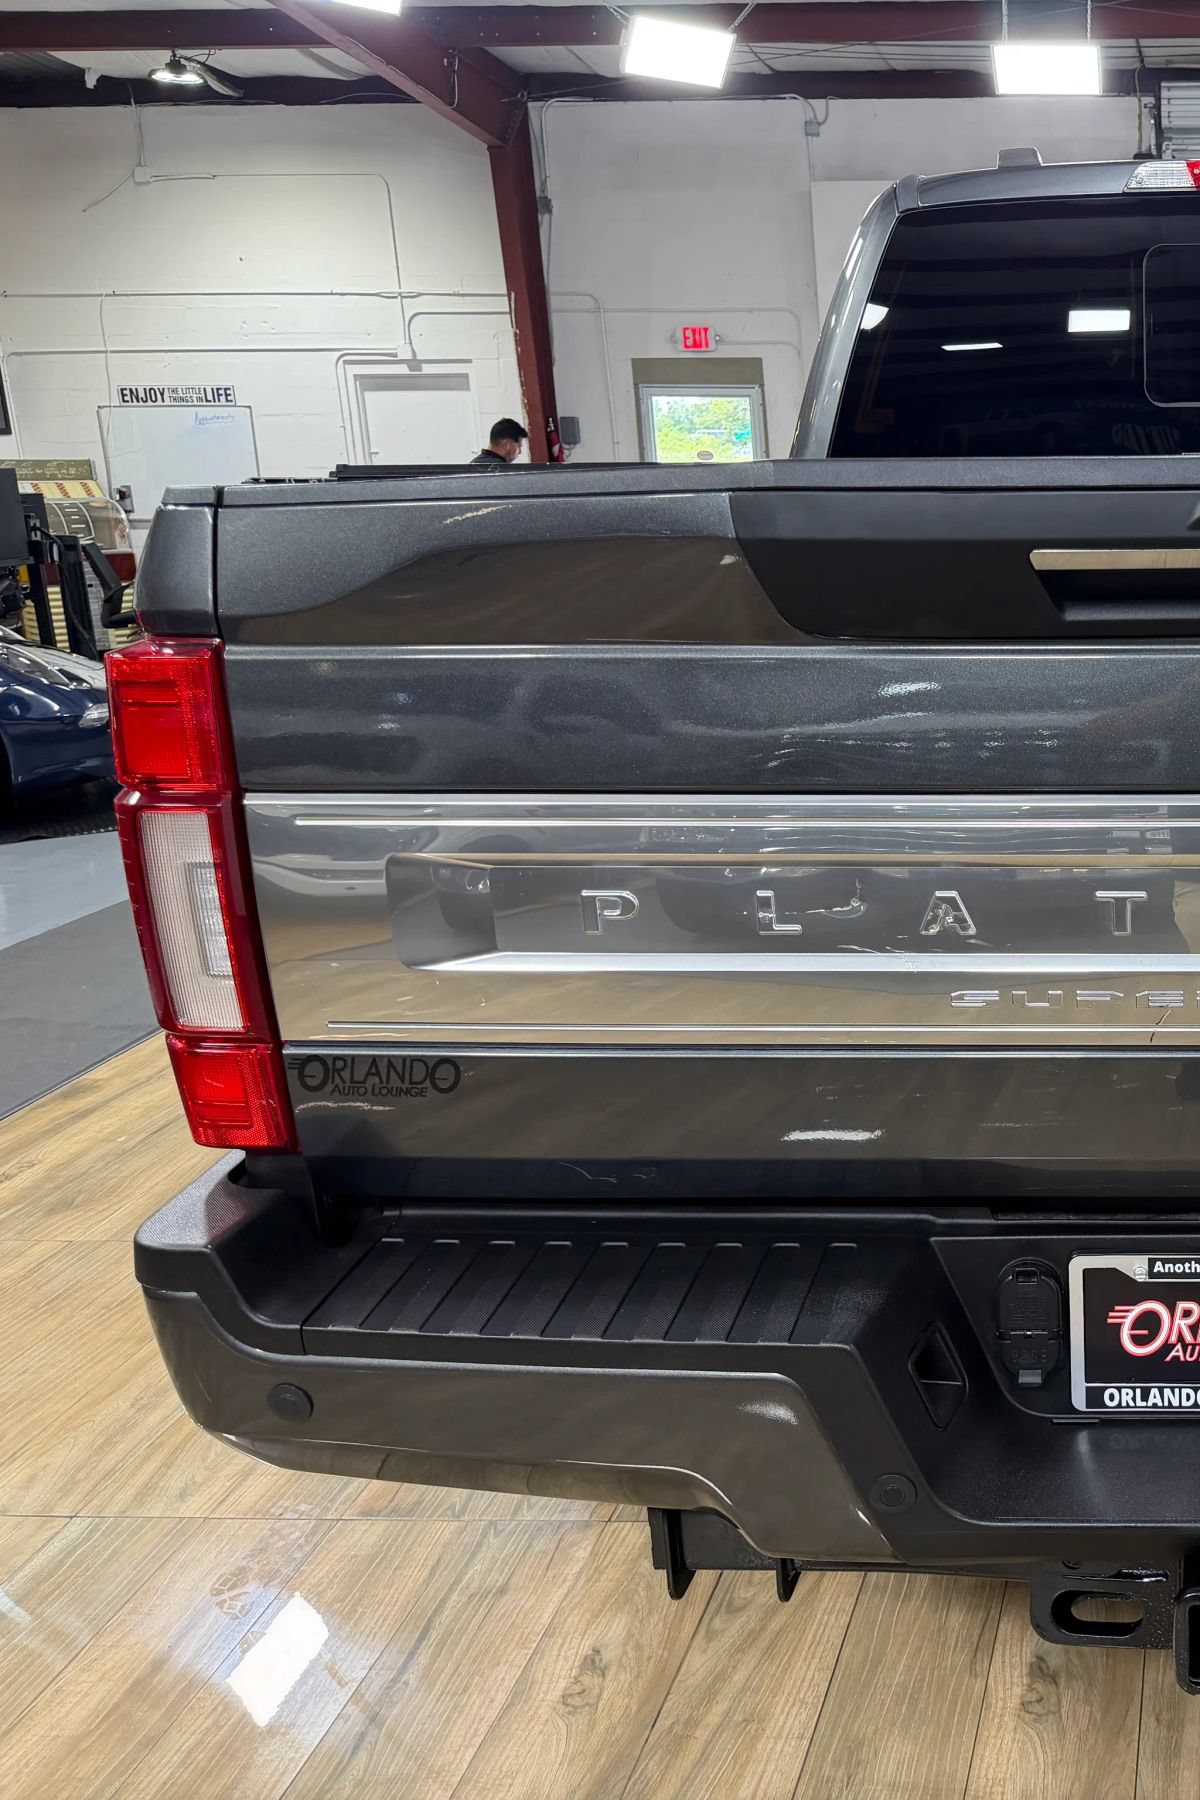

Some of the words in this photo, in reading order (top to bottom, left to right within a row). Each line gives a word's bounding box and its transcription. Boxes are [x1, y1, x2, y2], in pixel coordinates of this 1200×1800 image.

[682, 327, 709, 349] EXIT
[120, 387, 165, 403] ENJOY
[167, 387, 179, 395] THE
[181, 387, 202, 395] LITTLE
[168, 395, 194, 403] THINGS
[195, 395, 204, 403] IN
[203, 387, 233, 403] LIFE
[292, 1055, 462, 1094] ORLANDO
[330, 1083, 368, 1097] AUTO
[371, 1084, 428, 1098] LOUNGE
